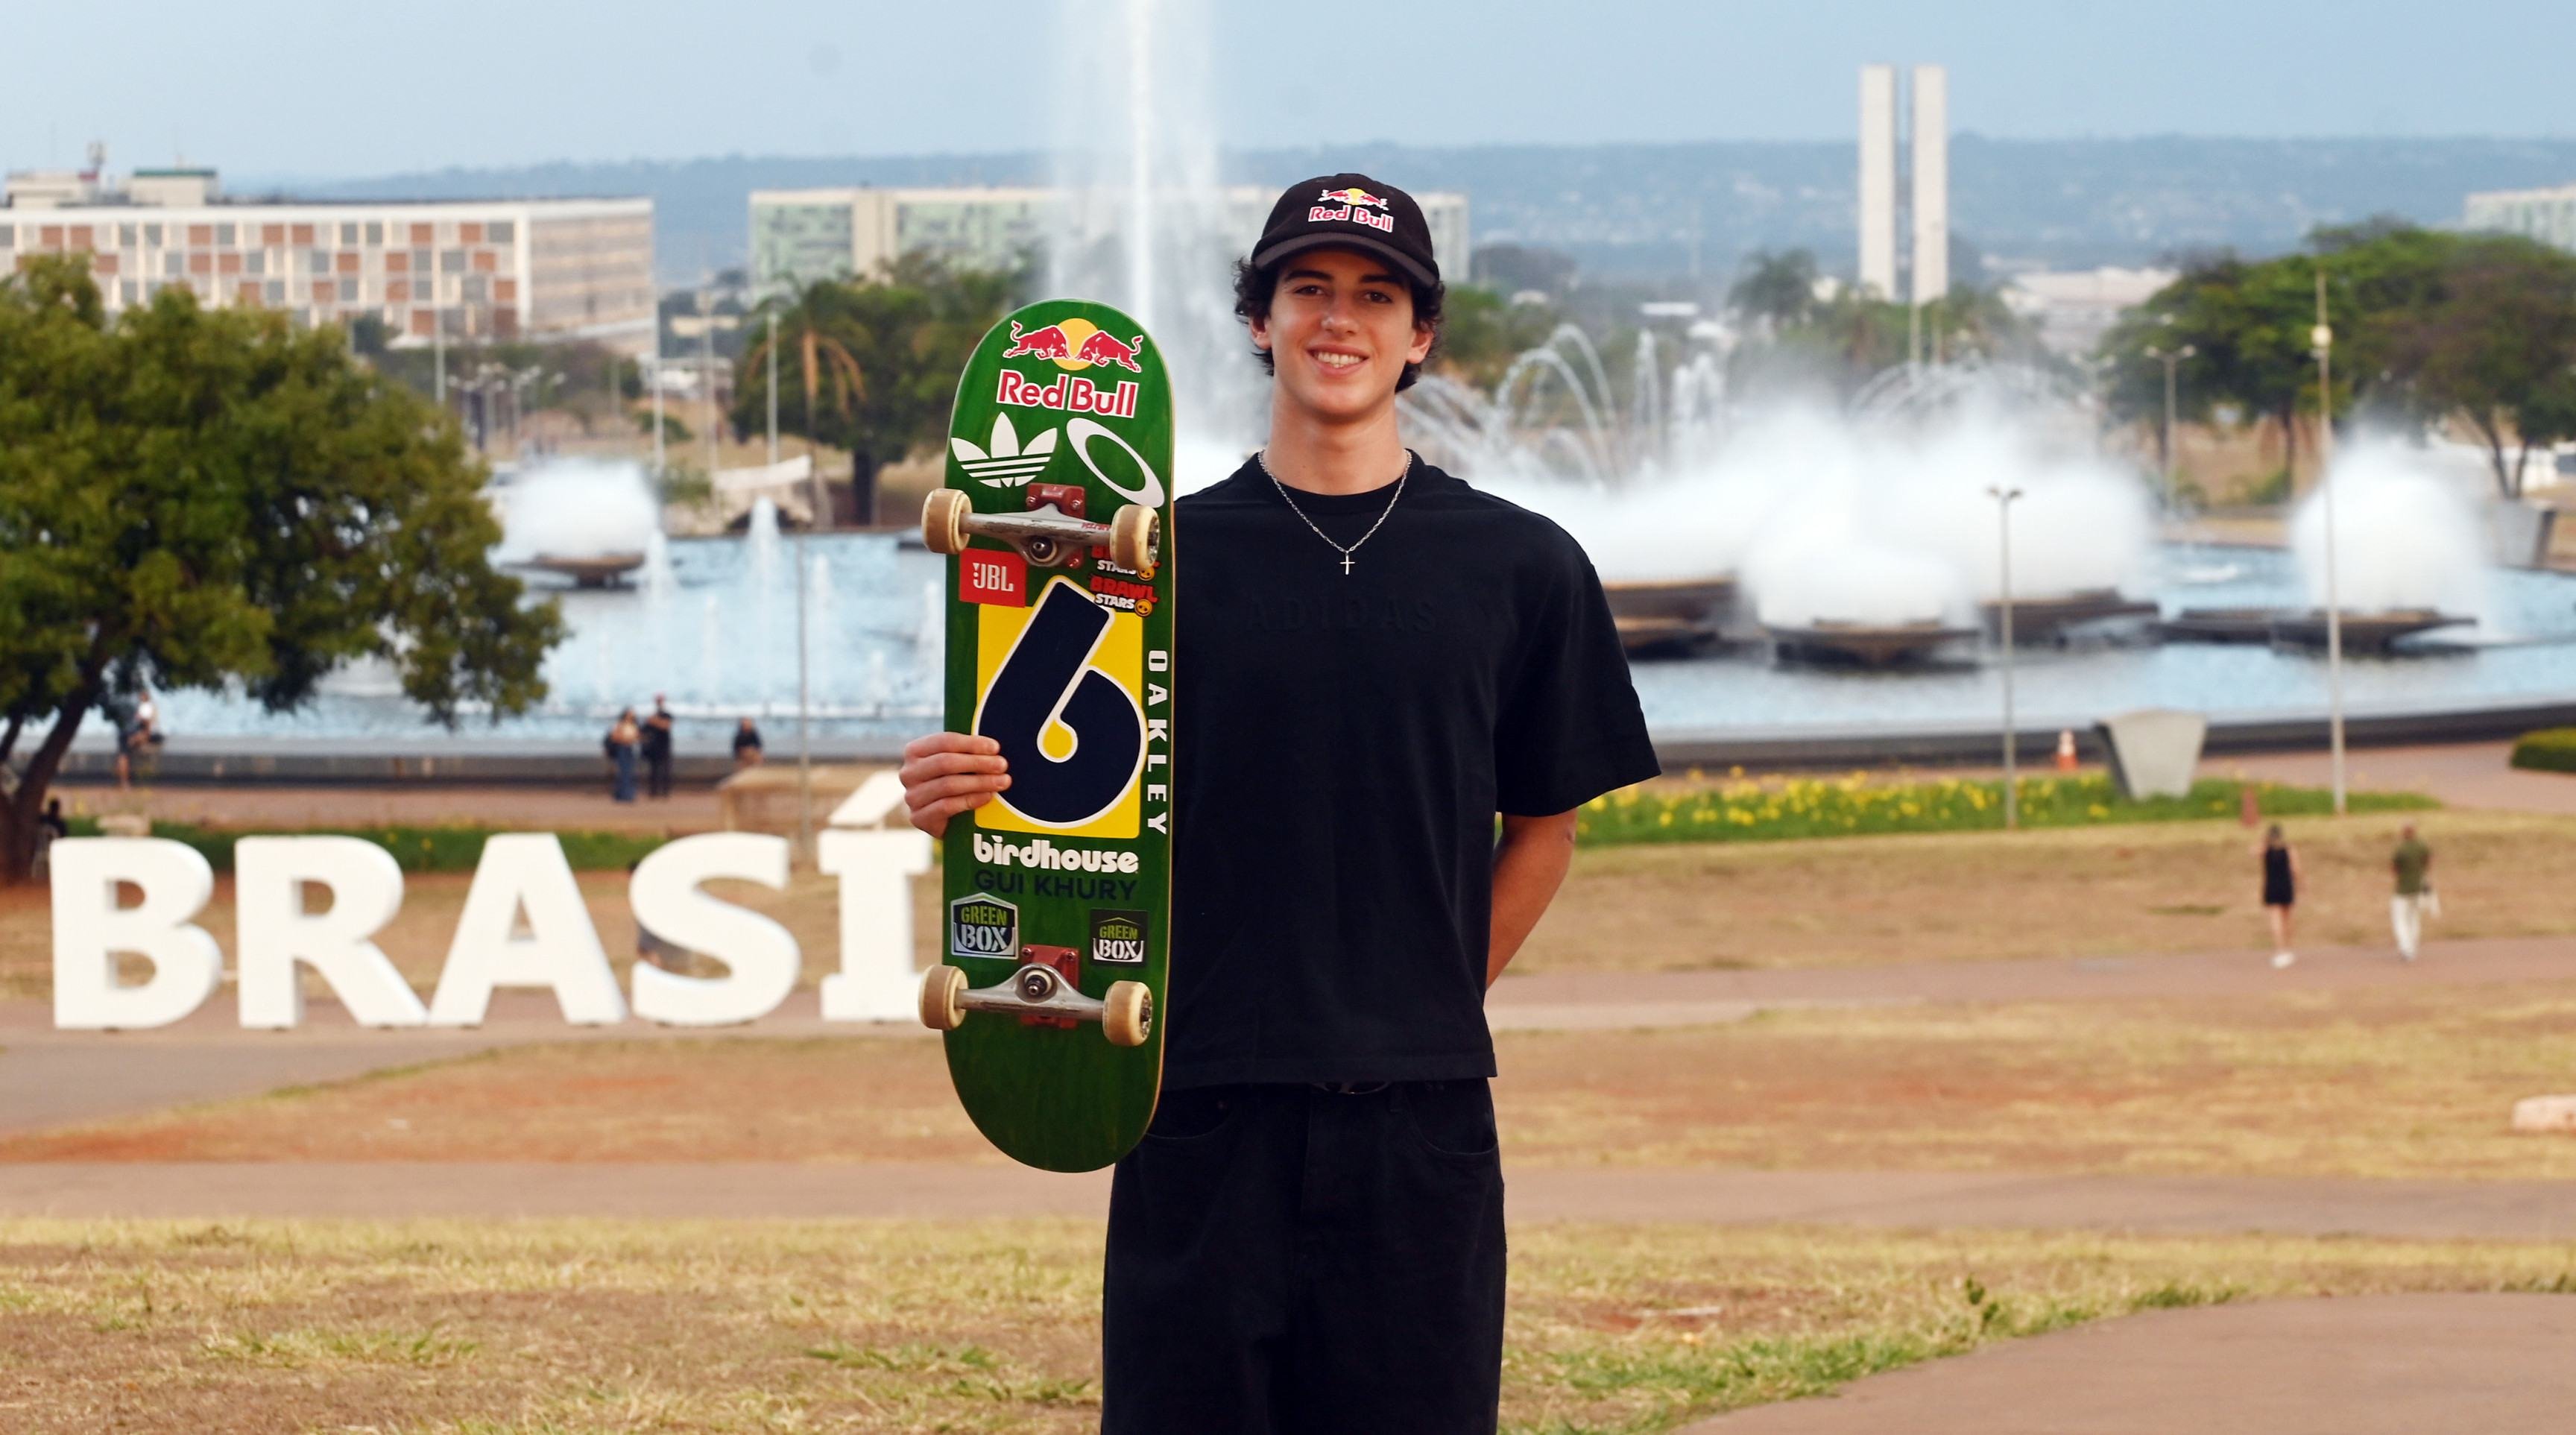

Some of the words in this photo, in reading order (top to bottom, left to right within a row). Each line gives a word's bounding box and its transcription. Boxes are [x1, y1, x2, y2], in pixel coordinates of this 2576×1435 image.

[1308, 205, 1351, 222] Red
[1352, 206, 1393, 233] Bull
[997, 369, 1067, 410] Red
[1068, 378, 1138, 418] Bull
[973, 563, 1014, 592] JBL
[1090, 576, 1158, 602] BRAWL
[1096, 593, 1135, 608] STARS
[1246, 593, 1437, 633] ADIDAS
[975, 579, 1143, 827] 6
[1148, 650, 1168, 835] OAKLEY
[973, 833, 1139, 874] birdhouse
[975, 869, 1024, 894] GUI
[1035, 874, 1138, 901] KHURY
[961, 905, 1008, 925] GREEN
[961, 924, 1008, 952] BOX
[1099, 924, 1138, 940] GREEN
[1099, 939, 1138, 959] BOX
